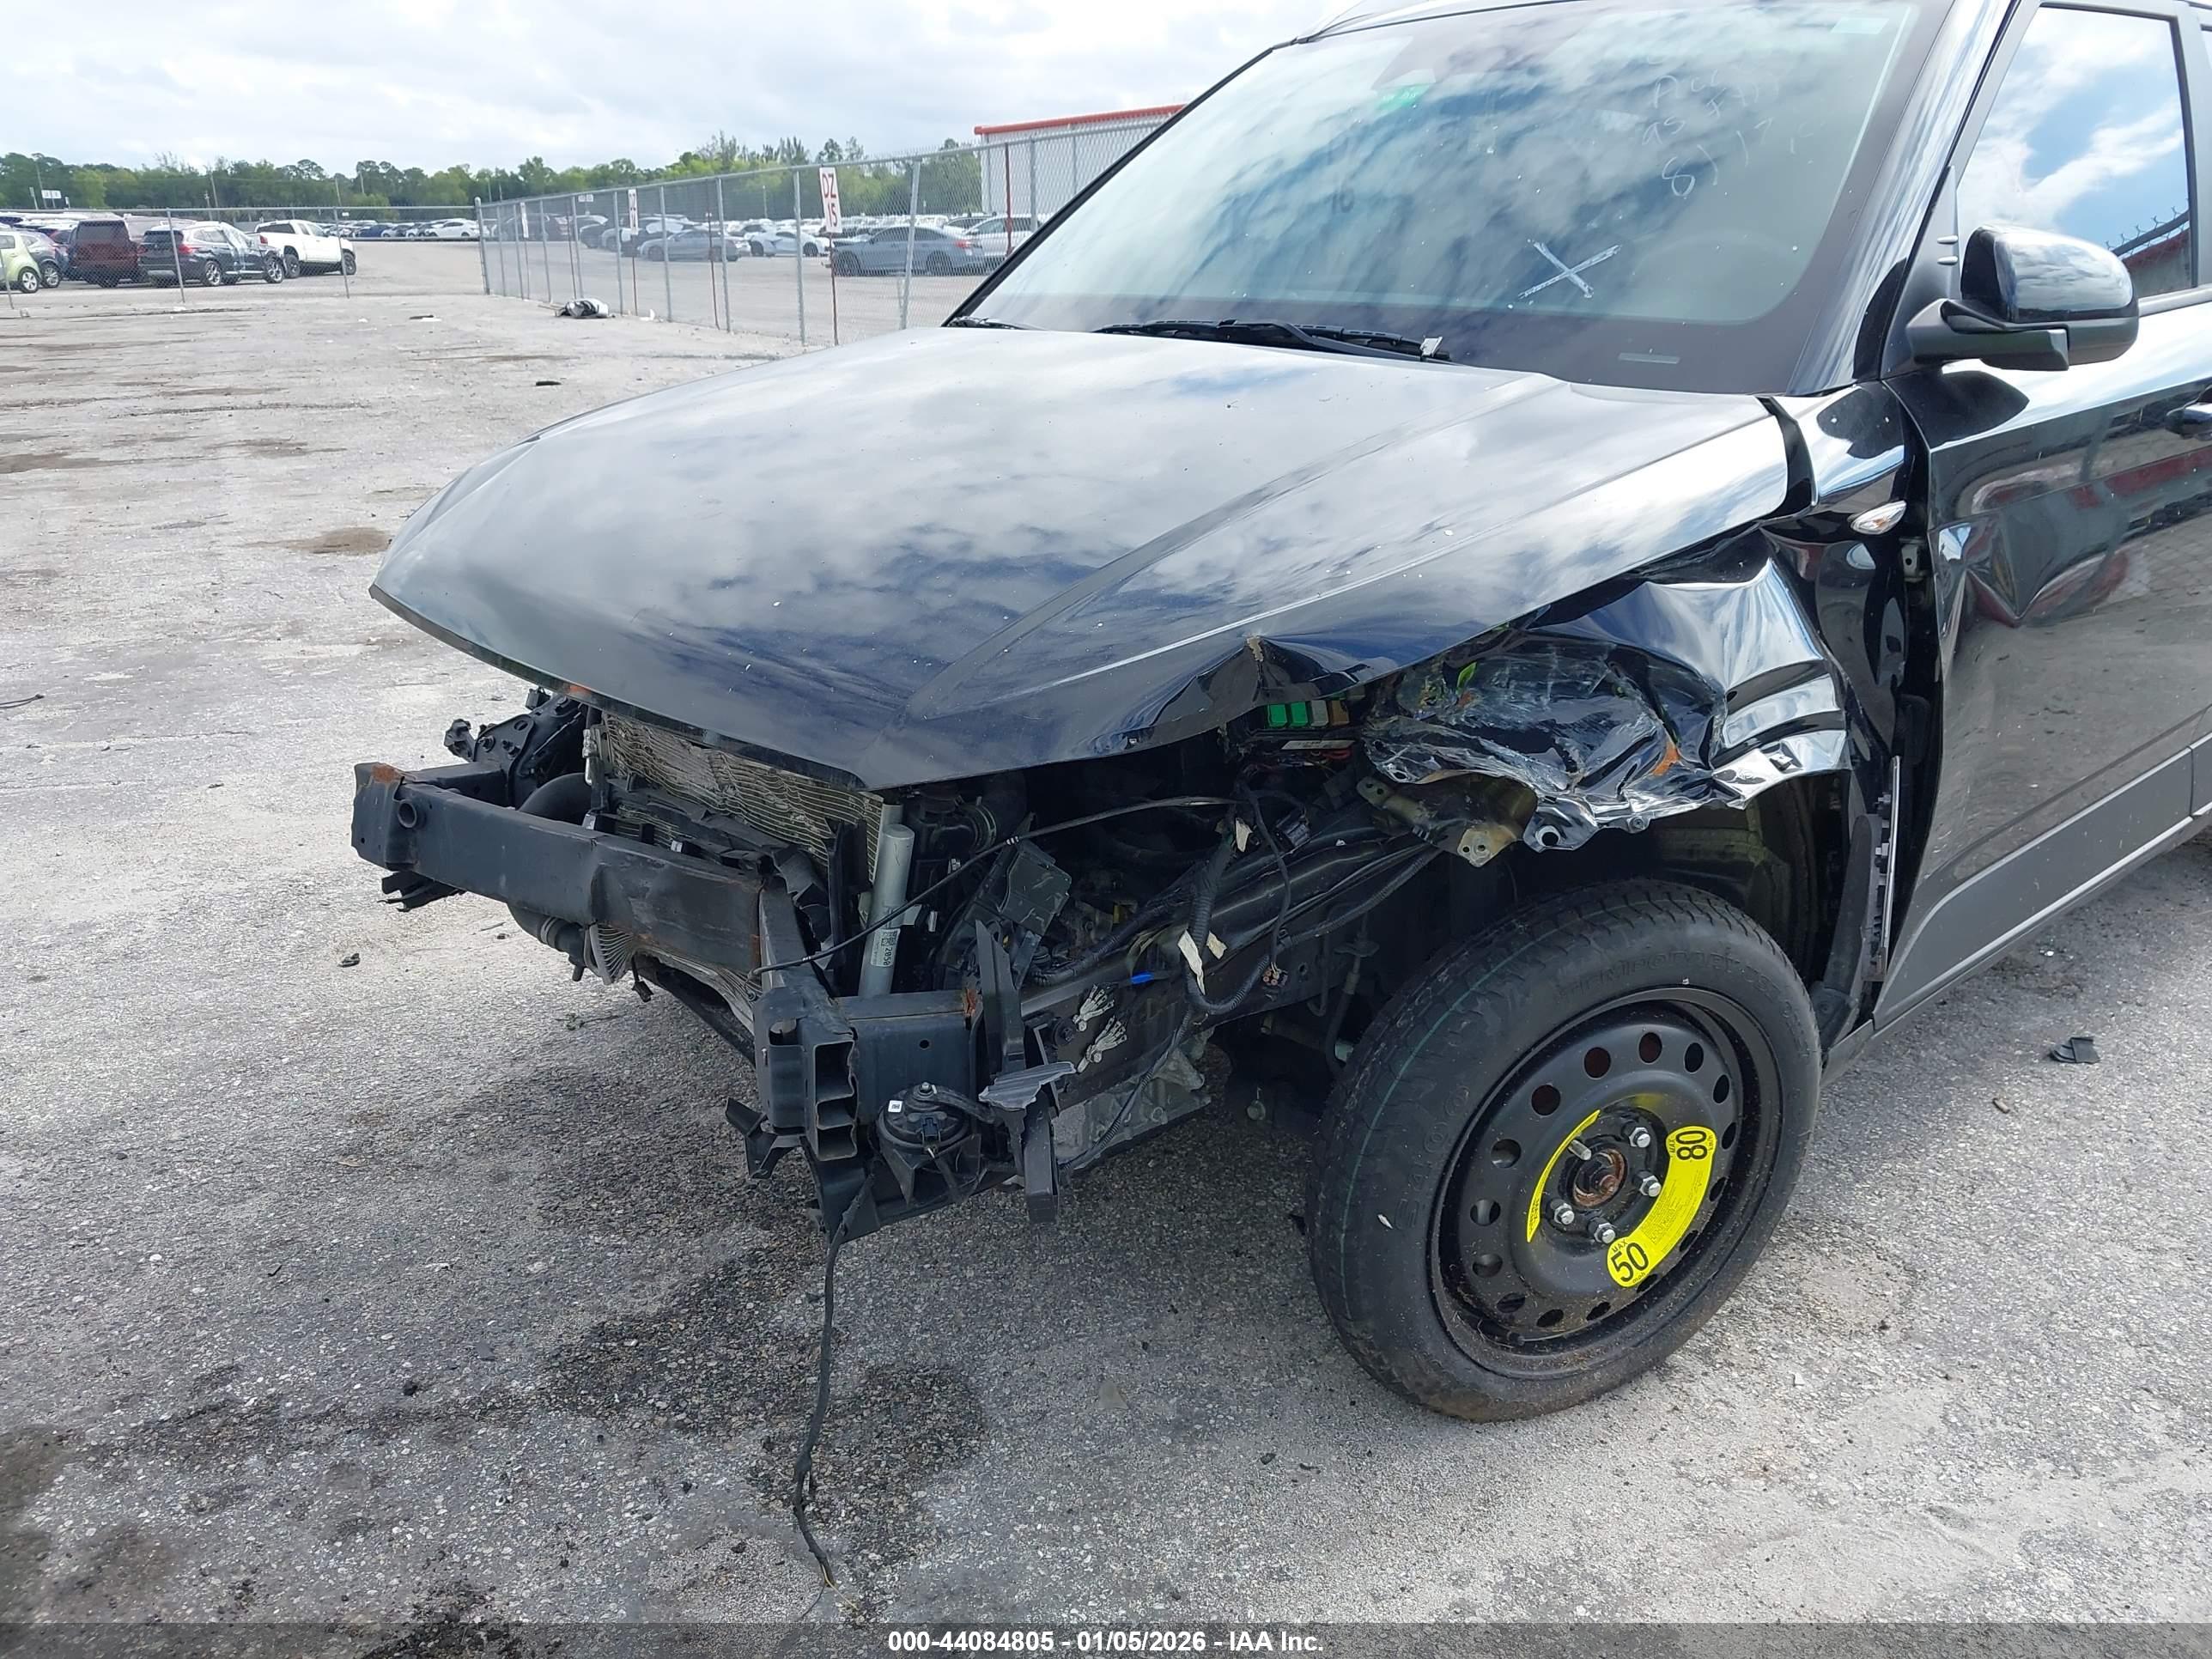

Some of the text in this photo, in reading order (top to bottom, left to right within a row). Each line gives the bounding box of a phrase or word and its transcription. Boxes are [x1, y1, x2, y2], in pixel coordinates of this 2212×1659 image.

[822, 173, 837, 198] DZ
[1676, 1130, 1708, 1160] 80
[1612, 1239, 1628, 1253] MAX
[1611, 1242, 1649, 1282] 50
